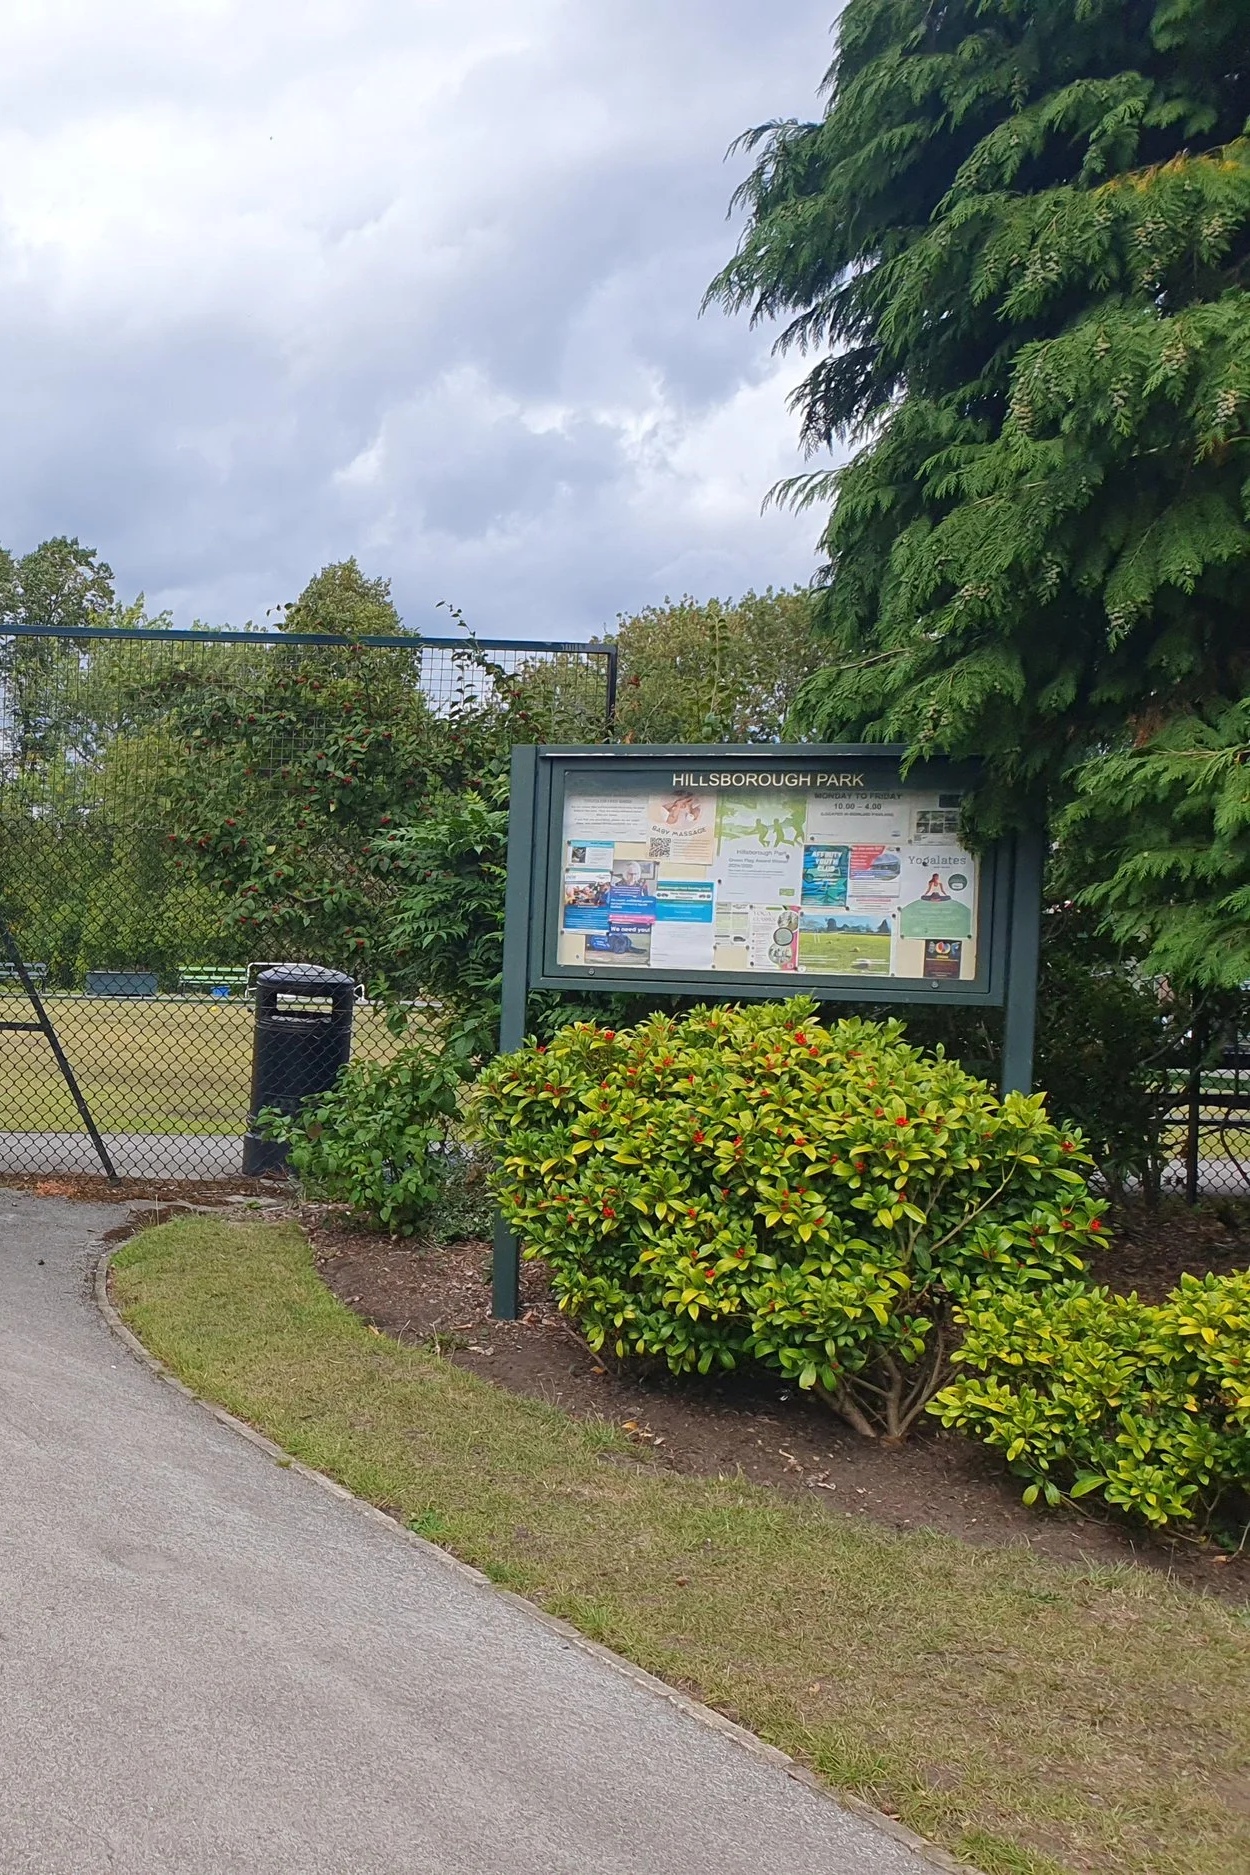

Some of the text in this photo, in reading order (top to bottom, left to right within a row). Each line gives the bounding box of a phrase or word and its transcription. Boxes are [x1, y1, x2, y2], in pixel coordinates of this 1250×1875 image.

[672, 773, 865, 787] HILLSBOROUGH PARK
[814, 792, 903, 800] MONDAY TO FRIDAY
[834, 802, 856, 810] 10.00
[651, 825, 707, 837] BABY MASSAGE
[908, 855, 967, 867] Yogalates
